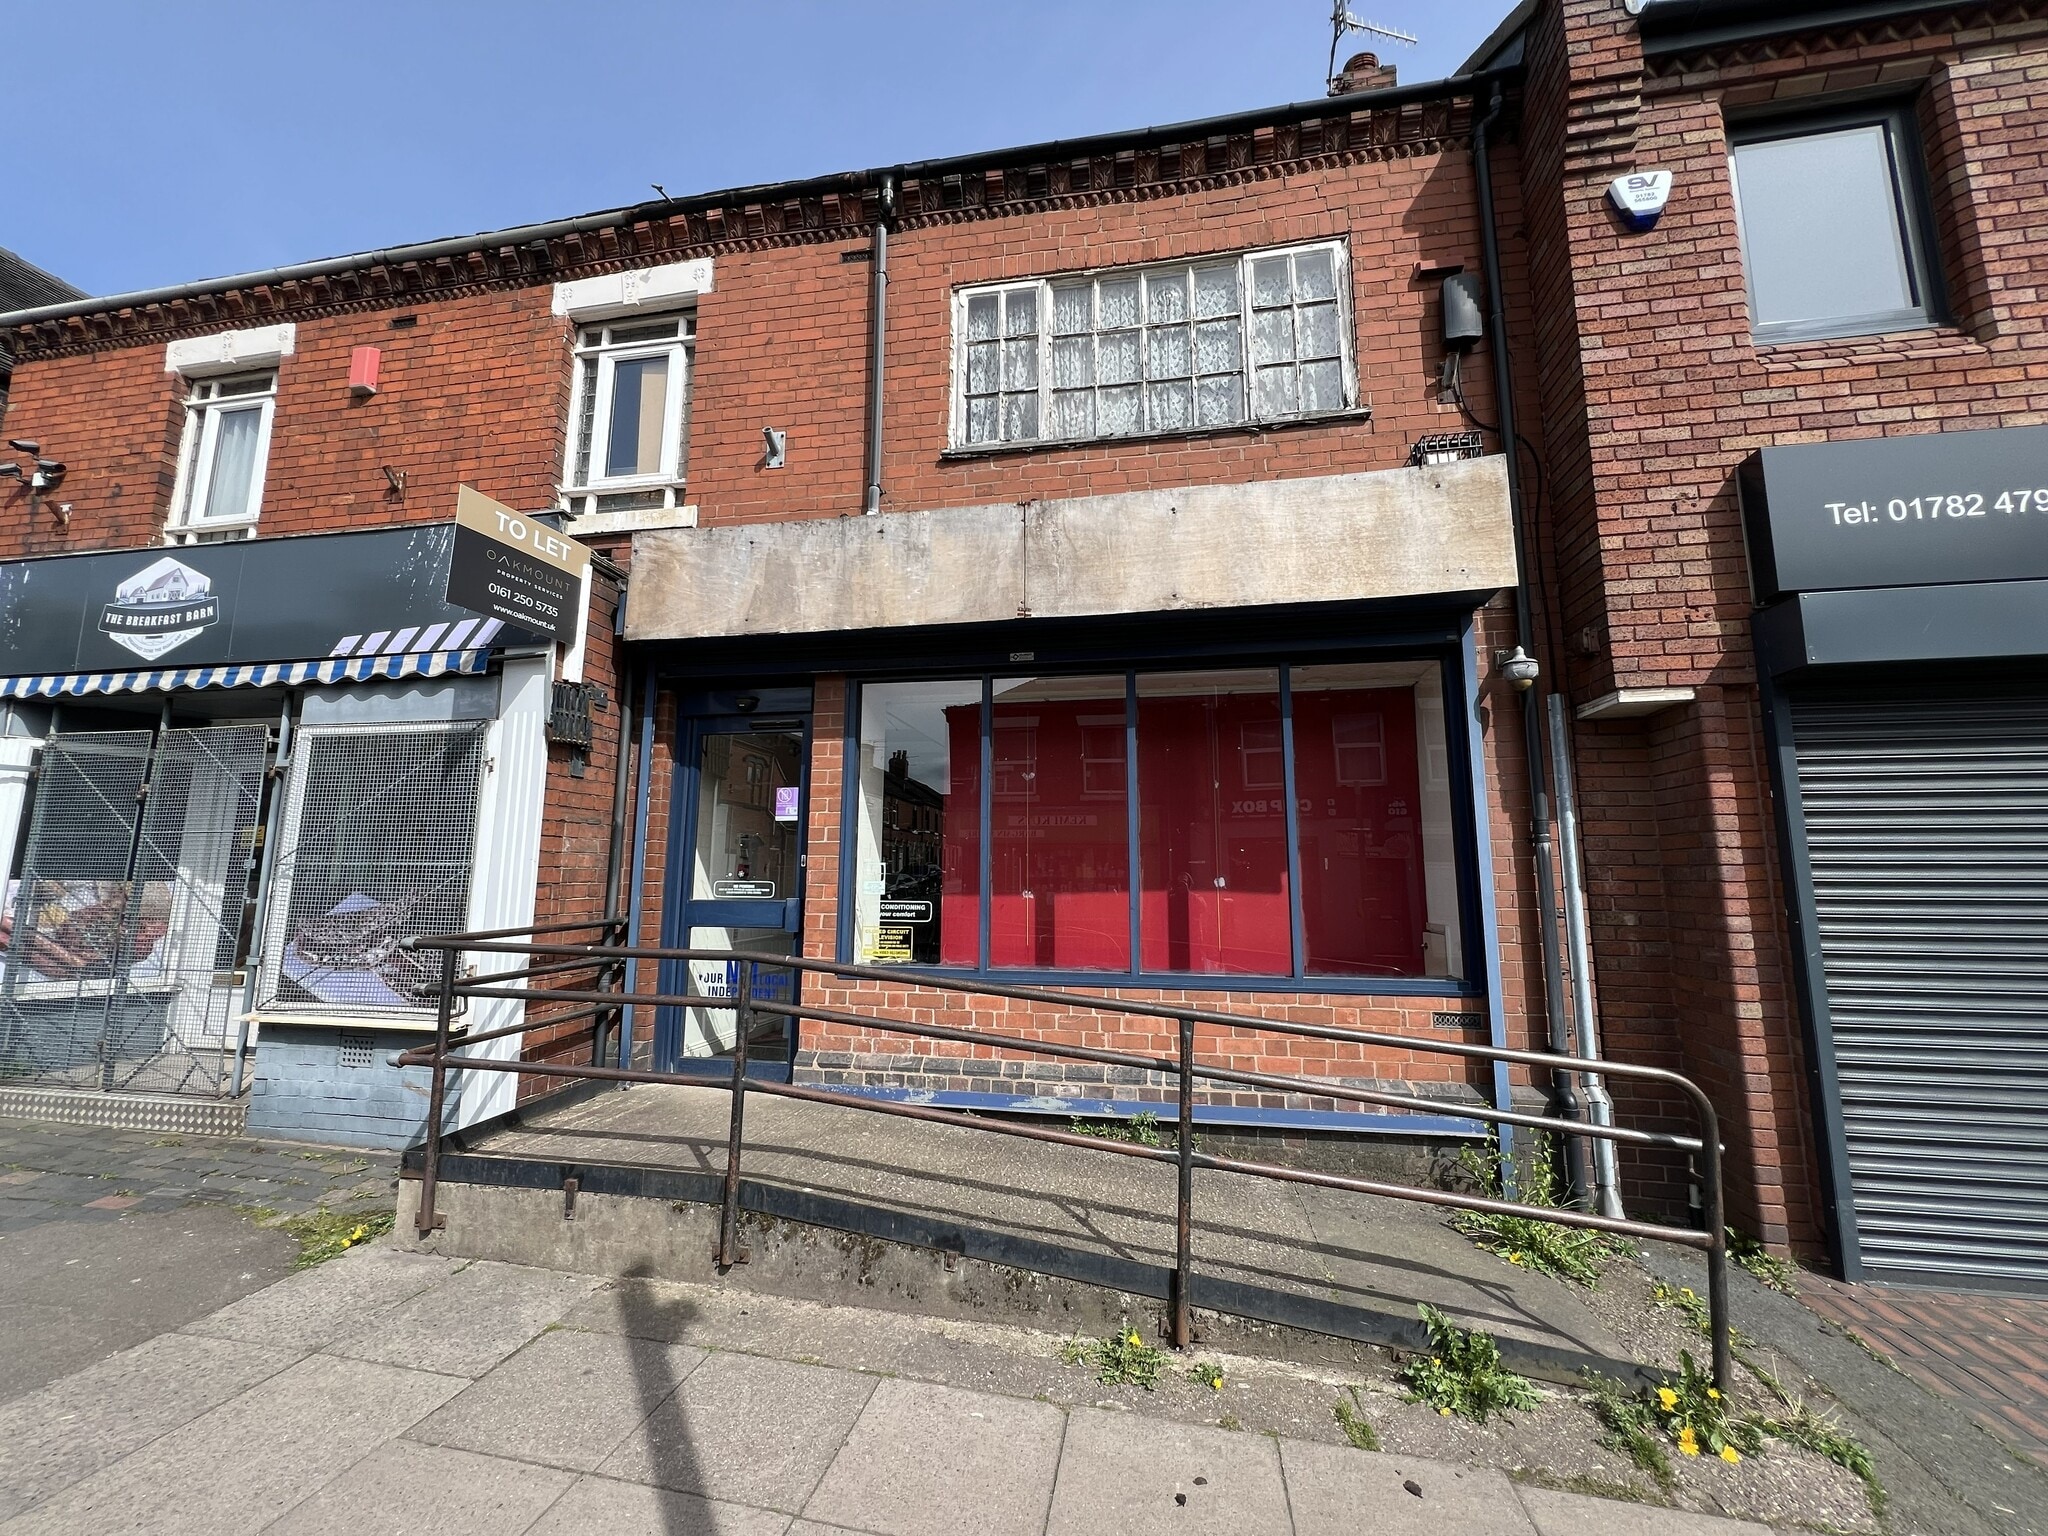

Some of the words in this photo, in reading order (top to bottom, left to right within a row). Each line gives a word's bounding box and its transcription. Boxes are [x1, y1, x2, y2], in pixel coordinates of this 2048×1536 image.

[1824, 501, 1879, 525] Tel:
[1888, 493, 1986, 521] 01782
[1994, 489, 2048, 514] 479
[495, 510, 527, 541] TO
[533, 530, 572, 561] LET
[486, 549, 571, 592] OAKMOUNT
[496, 568, 532, 587] PROPERTY
[534, 584, 563, 600] SERVICES
[105, 612, 124, 625] THE
[125, 613, 182, 626] BREAKFAST
[186, 605, 214, 622] BARN
[488, 582, 512, 600] 0161
[513, 592, 534, 608] 250
[535, 601, 559, 617] 5735
